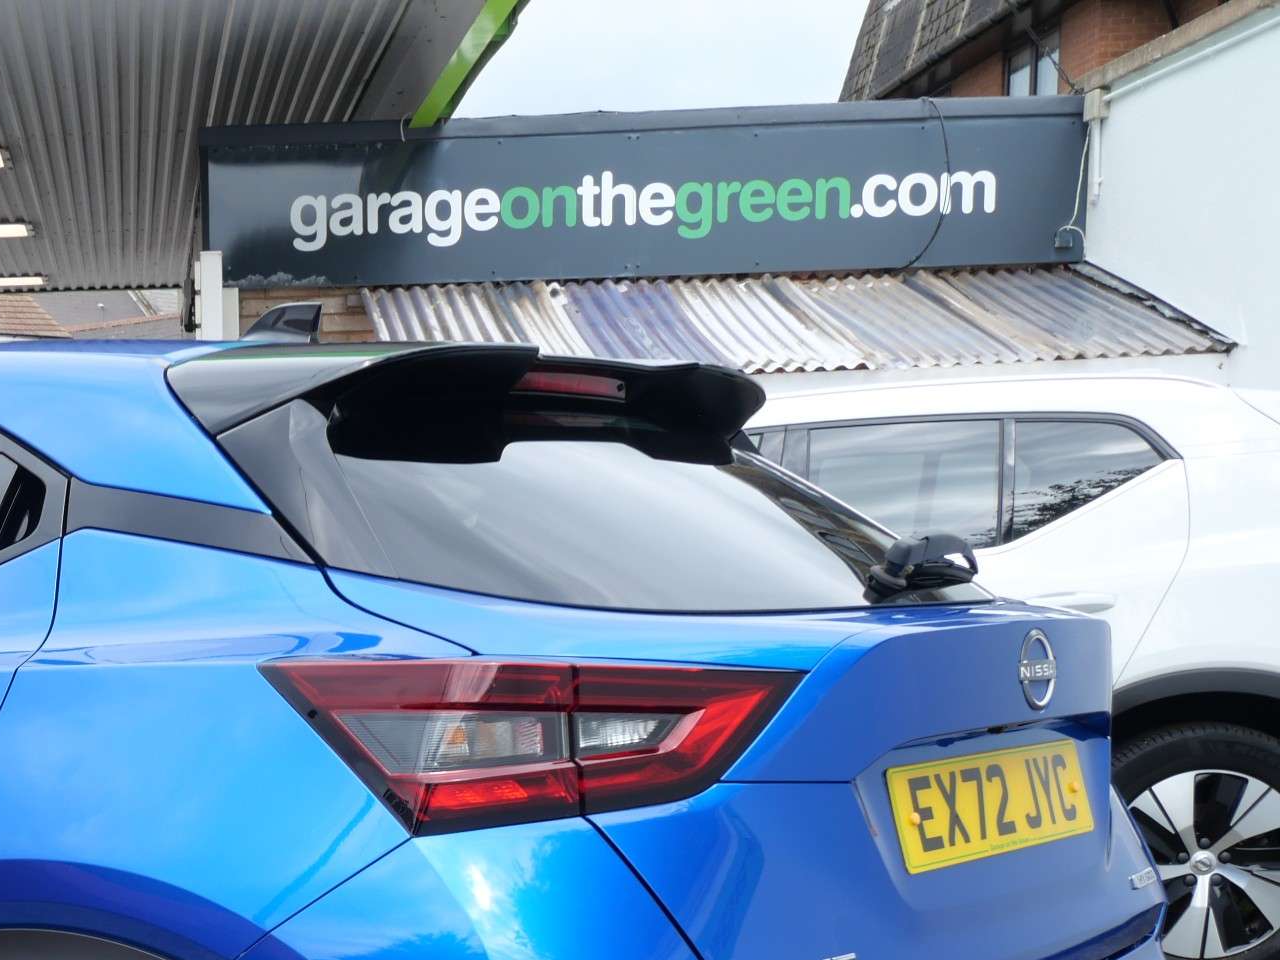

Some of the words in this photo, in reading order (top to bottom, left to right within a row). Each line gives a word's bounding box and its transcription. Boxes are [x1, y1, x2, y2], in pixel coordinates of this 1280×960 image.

[290, 170, 997, 252] garageonthegreen.com
[907, 763, 1017, 853] EX72
[1024, 754, 1077, 829] JYC
